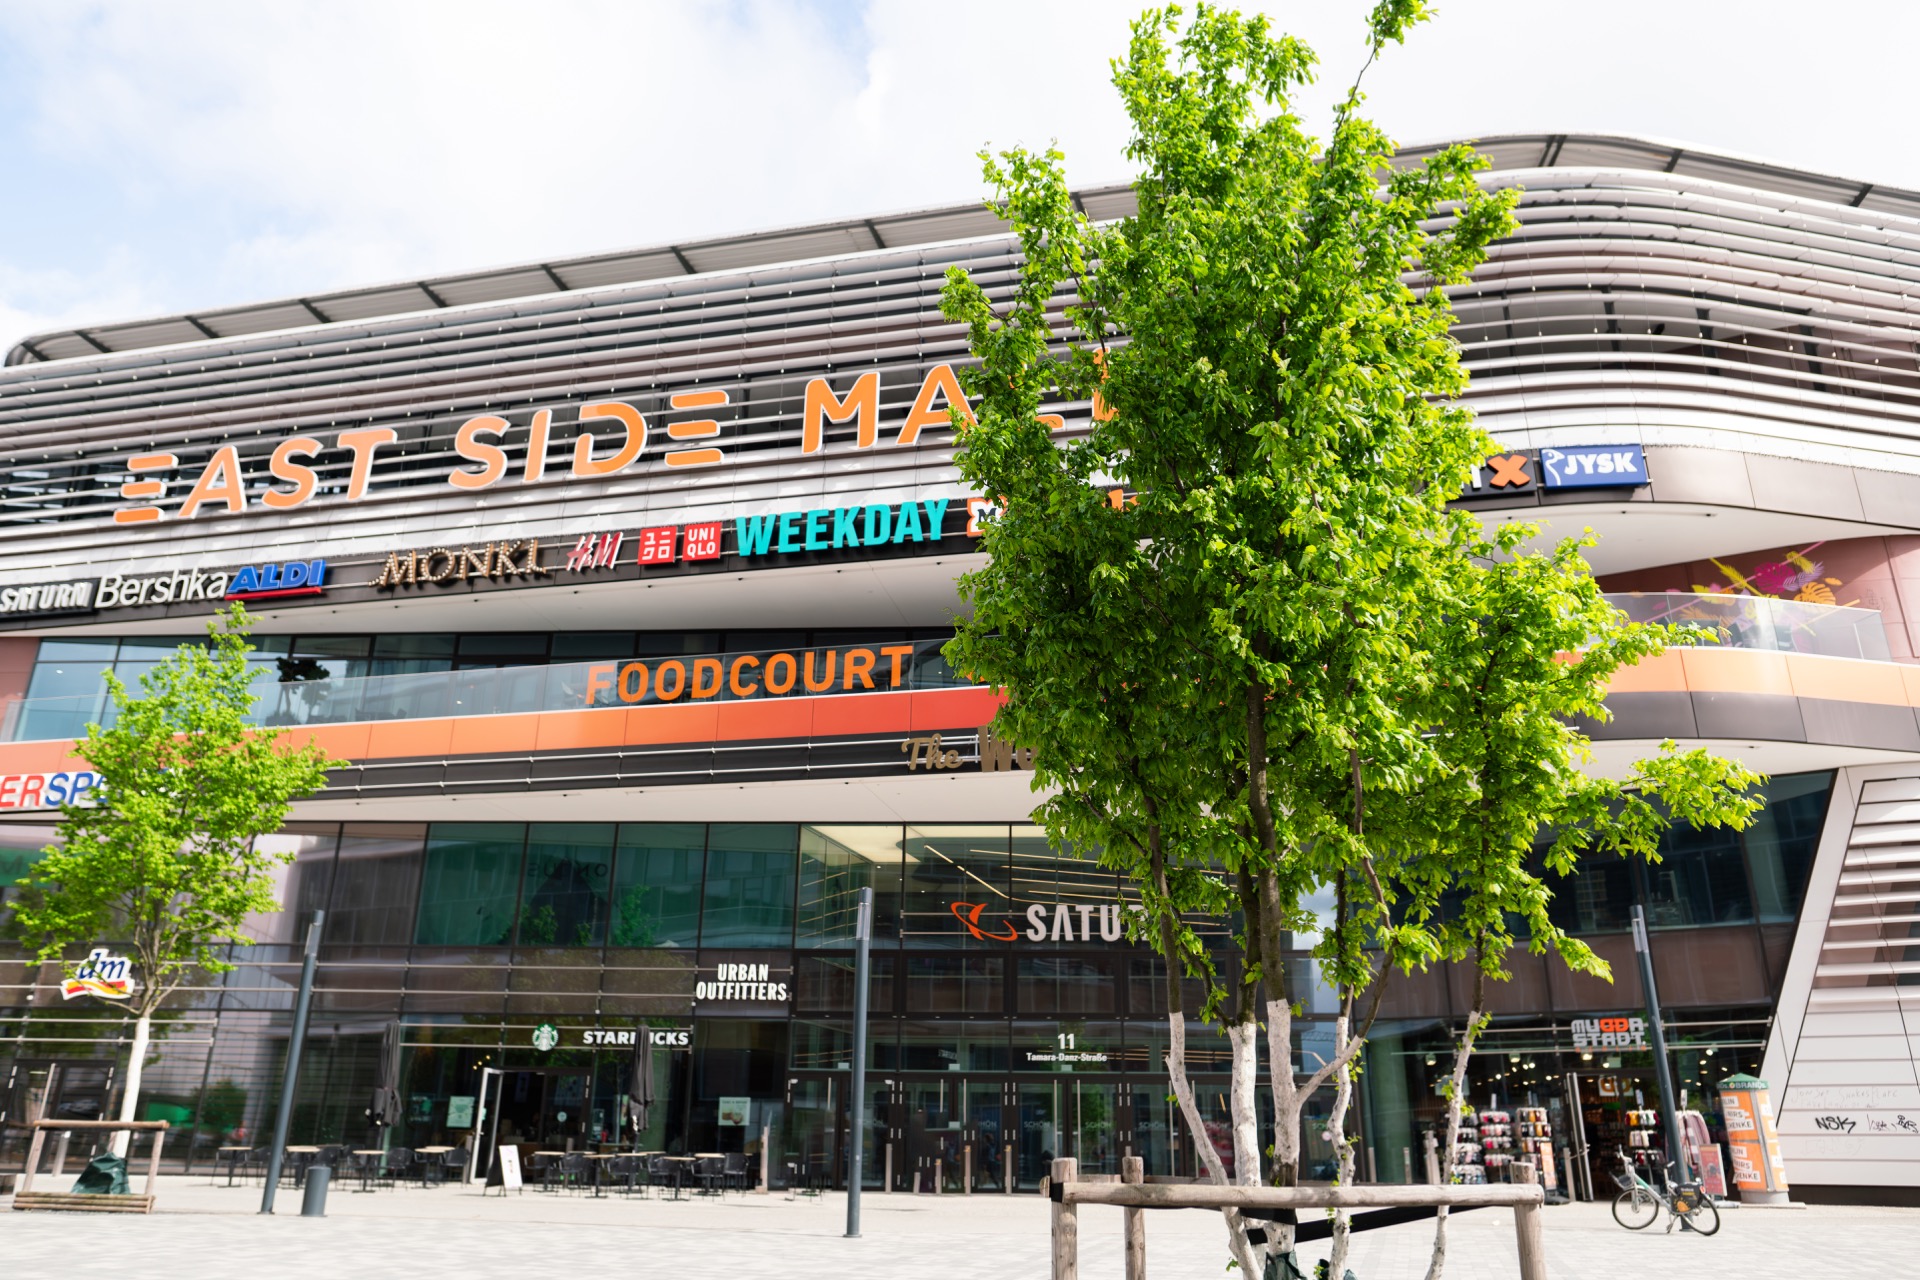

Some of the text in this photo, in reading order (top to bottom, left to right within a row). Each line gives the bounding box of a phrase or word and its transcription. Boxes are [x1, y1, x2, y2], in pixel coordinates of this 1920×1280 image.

[113, 427, 398, 524] EAST
[447, 389, 731, 490] SIDE
[1564, 452, 1637, 475] JYSK
[688, 526, 715, 542] UNI
[735, 497, 949, 557] WEEKDAY
[566, 531, 624, 572] H&M
[686, 542, 716, 558] QLO
[94, 565, 229, 608] Bershka
[226, 559, 327, 596] ALDI
[0, 581, 93, 613] SATURN
[584, 645, 914, 706] FOODCOURT
[901, 732, 964, 771] The
[78, 952, 126, 979] dm
[717, 963, 769, 981] URBAN
[695, 981, 787, 1001] OUTFITTERS
[582, 1030, 689, 1046] STARCKS
[1057, 1033, 1075, 1050] 11
[1025, 1052, 1108, 1062] Tamara-Danz-Straße
